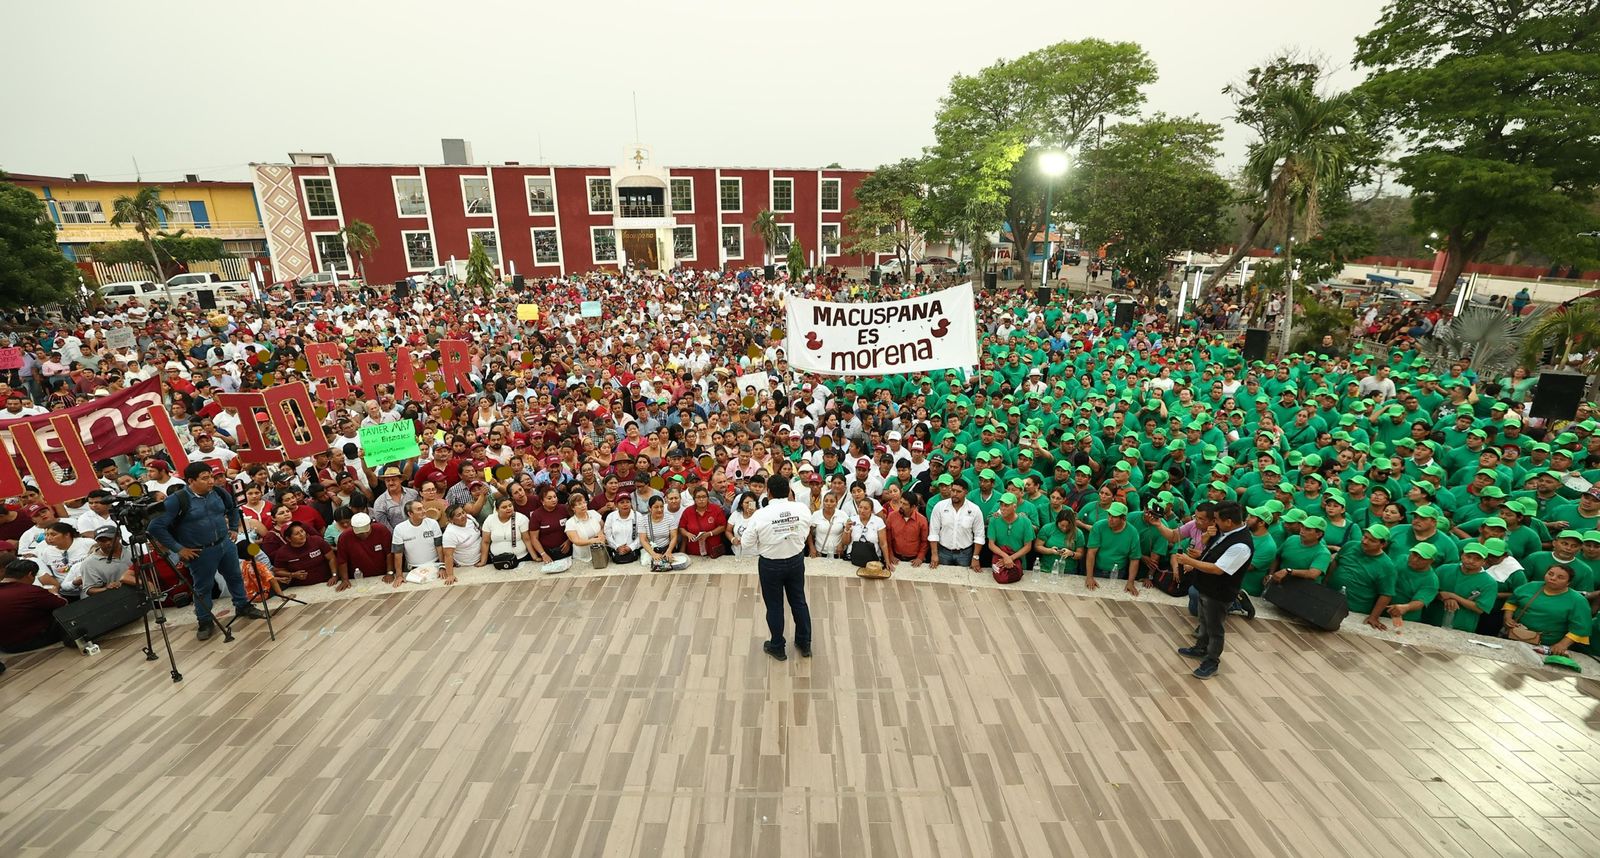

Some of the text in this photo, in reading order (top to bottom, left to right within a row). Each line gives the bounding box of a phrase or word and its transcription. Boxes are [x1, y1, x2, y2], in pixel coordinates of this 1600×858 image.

[813, 300, 943, 326] MACUSPANA
[857, 328, 880, 345] ES
[830, 338, 933, 371] morena
[391, 419, 410, 432] MAY
